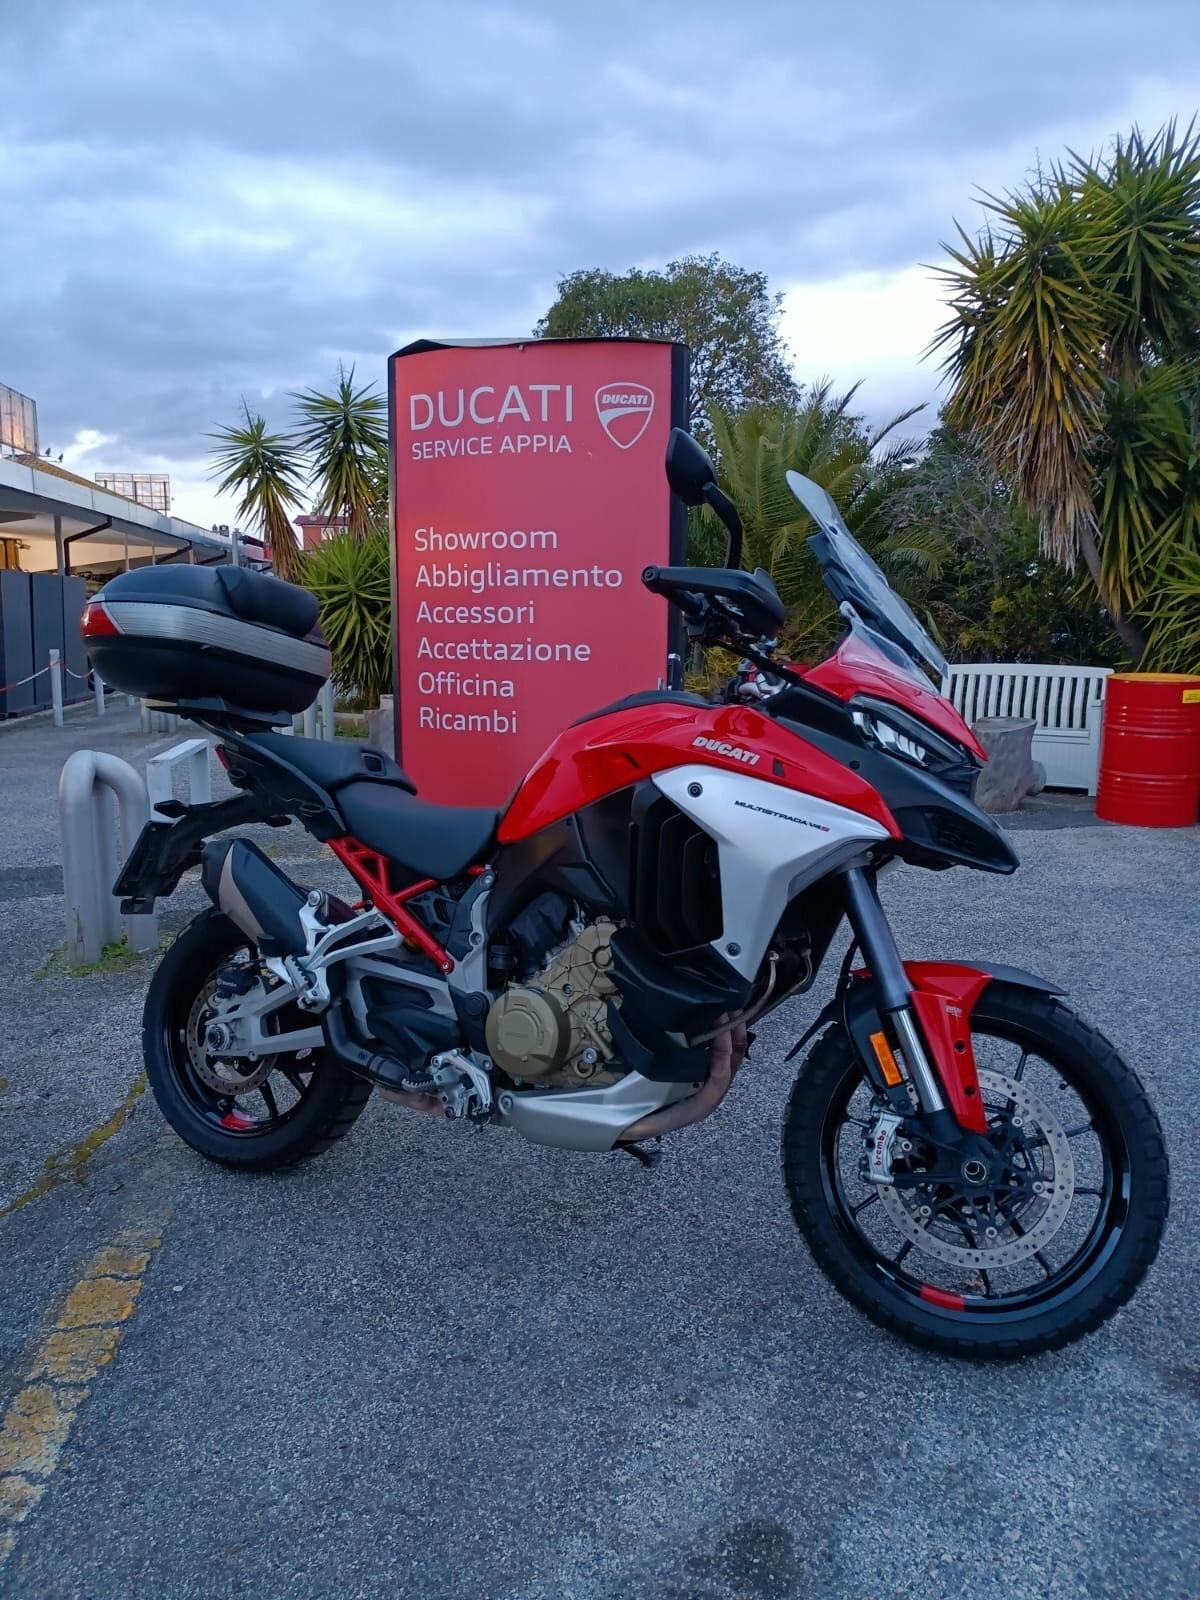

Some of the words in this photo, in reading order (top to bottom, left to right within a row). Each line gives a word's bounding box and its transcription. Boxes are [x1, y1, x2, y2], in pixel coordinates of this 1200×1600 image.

[410, 384, 573, 431] DUCATI
[602, 394, 648, 405] DUCATI
[411, 436, 492, 460] SERVICE
[499, 434, 572, 454] APPIA
[414, 528, 558, 552] Showroom
[415, 562, 623, 594] Abbigliamento
[416, 600, 535, 624] Accessori
[417, 637, 591, 662] Accettazione
[418, 671, 515, 697] Officina
[419, 707, 517, 733] Ricambi
[692, 736, 760, 765] DUCATI
[734, 800, 808, 826] MULTISTRADA
[873, 1129, 887, 1166] brembo
